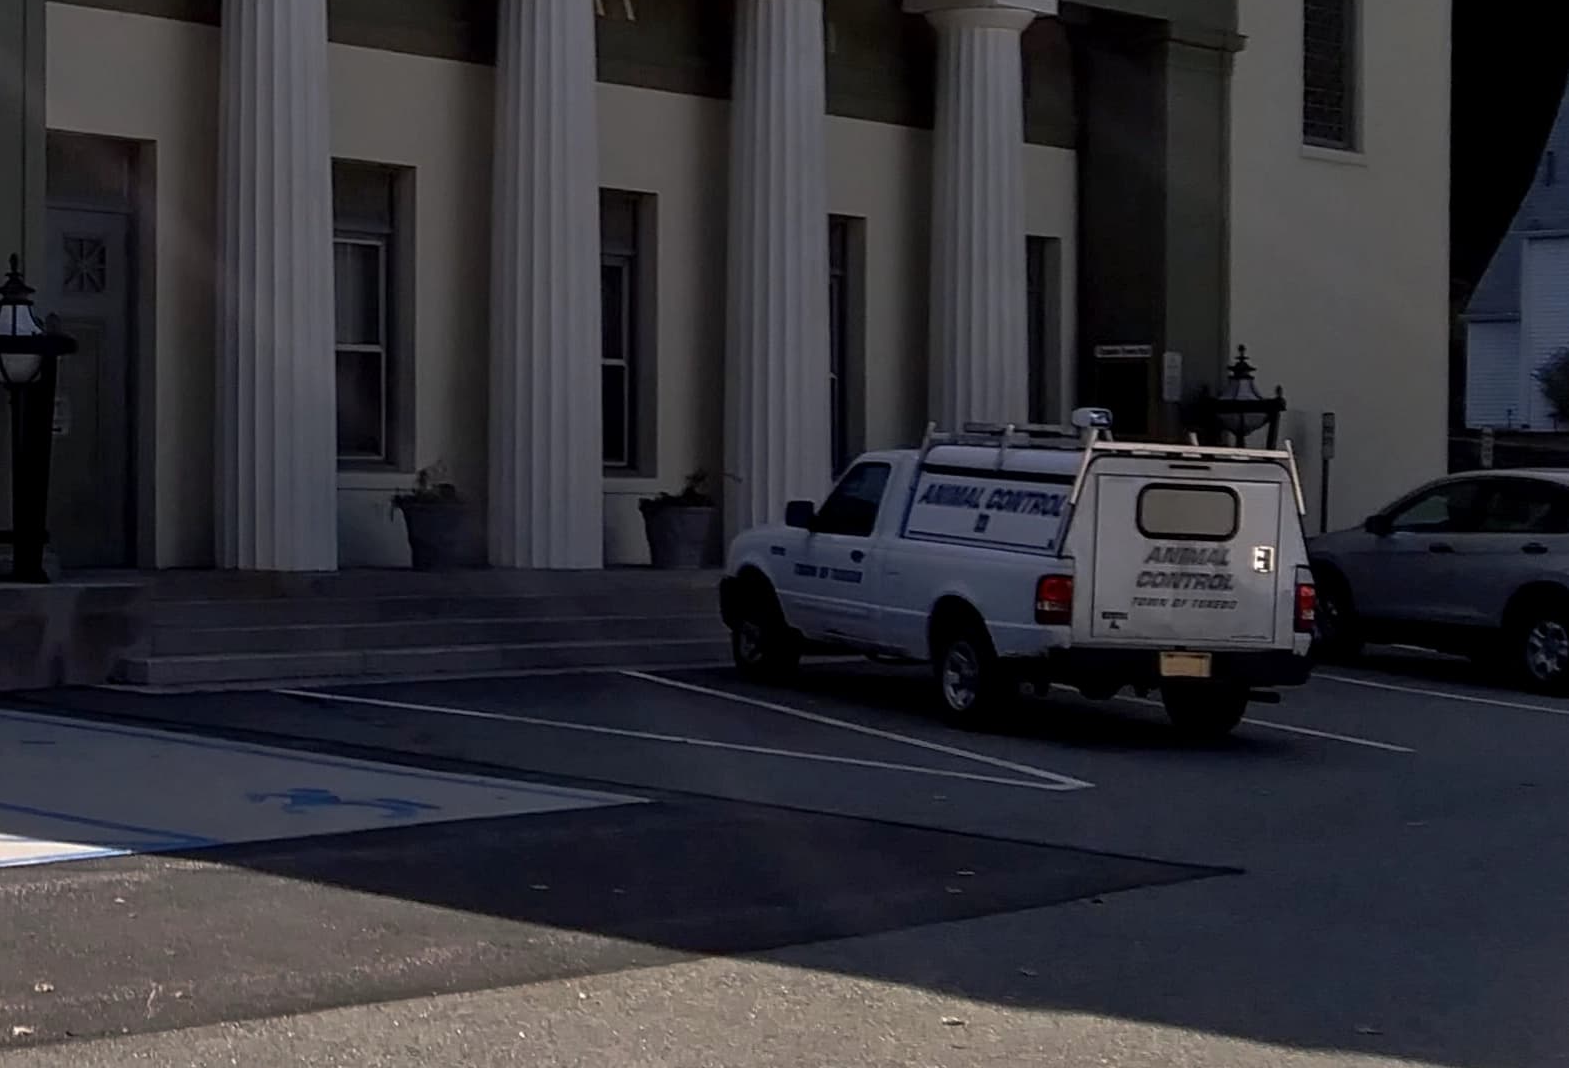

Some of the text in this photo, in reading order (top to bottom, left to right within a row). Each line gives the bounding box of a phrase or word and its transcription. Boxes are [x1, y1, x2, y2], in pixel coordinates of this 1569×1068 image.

[918, 483, 1067, 516] ANIMAL CONTROL
[1144, 546, 1232, 566] ANIMAL
[1136, 571, 1236, 590] CONTROL
[1132, 596, 1239, 610] TOWN OF TUXEDO
